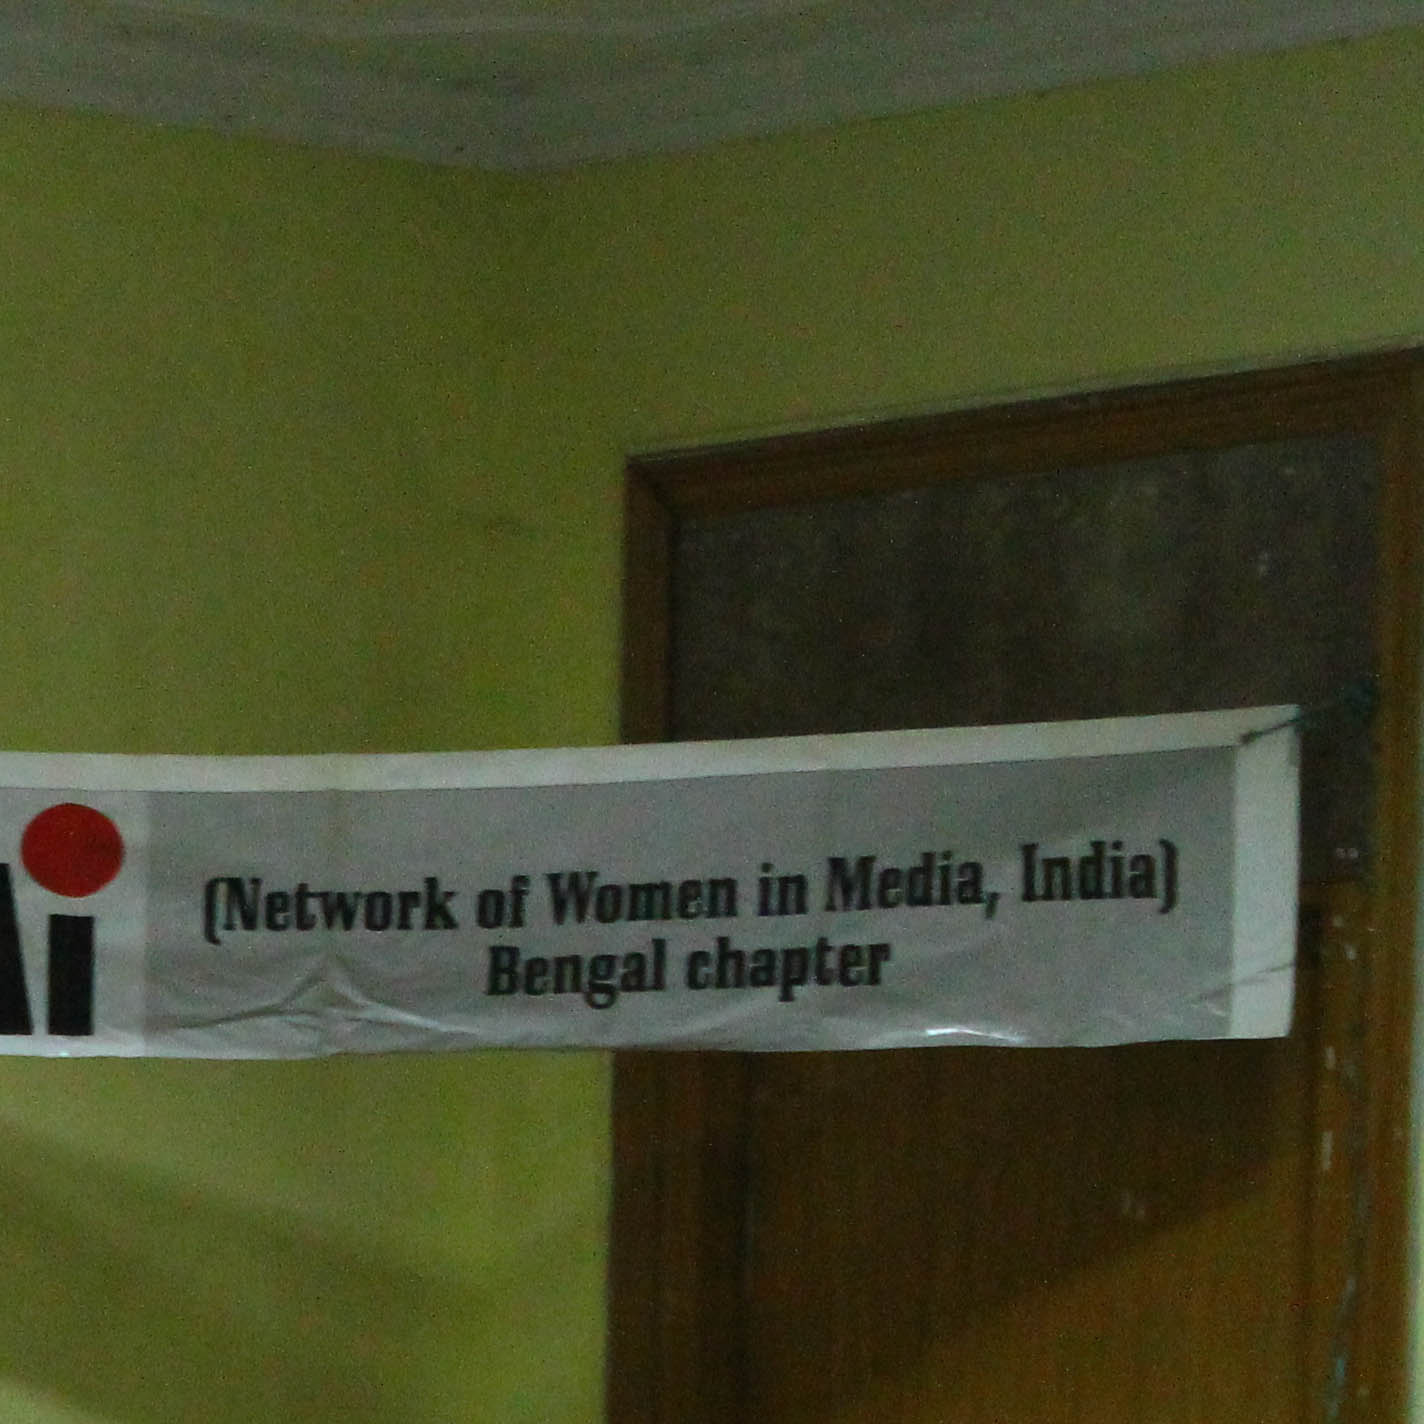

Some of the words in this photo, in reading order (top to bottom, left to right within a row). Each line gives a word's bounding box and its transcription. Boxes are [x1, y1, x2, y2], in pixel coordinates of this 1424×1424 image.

[203, 876, 460, 945] (Network
[475, 875, 531, 929] of
[545, 871, 739, 925] Women
[758, 862, 808, 916] in
[824, 850, 1000, 920] Media,
[1020, 838, 1179, 915] India)
[486, 938, 667, 1009] Bengal
[686, 936, 892, 1002] chapter
